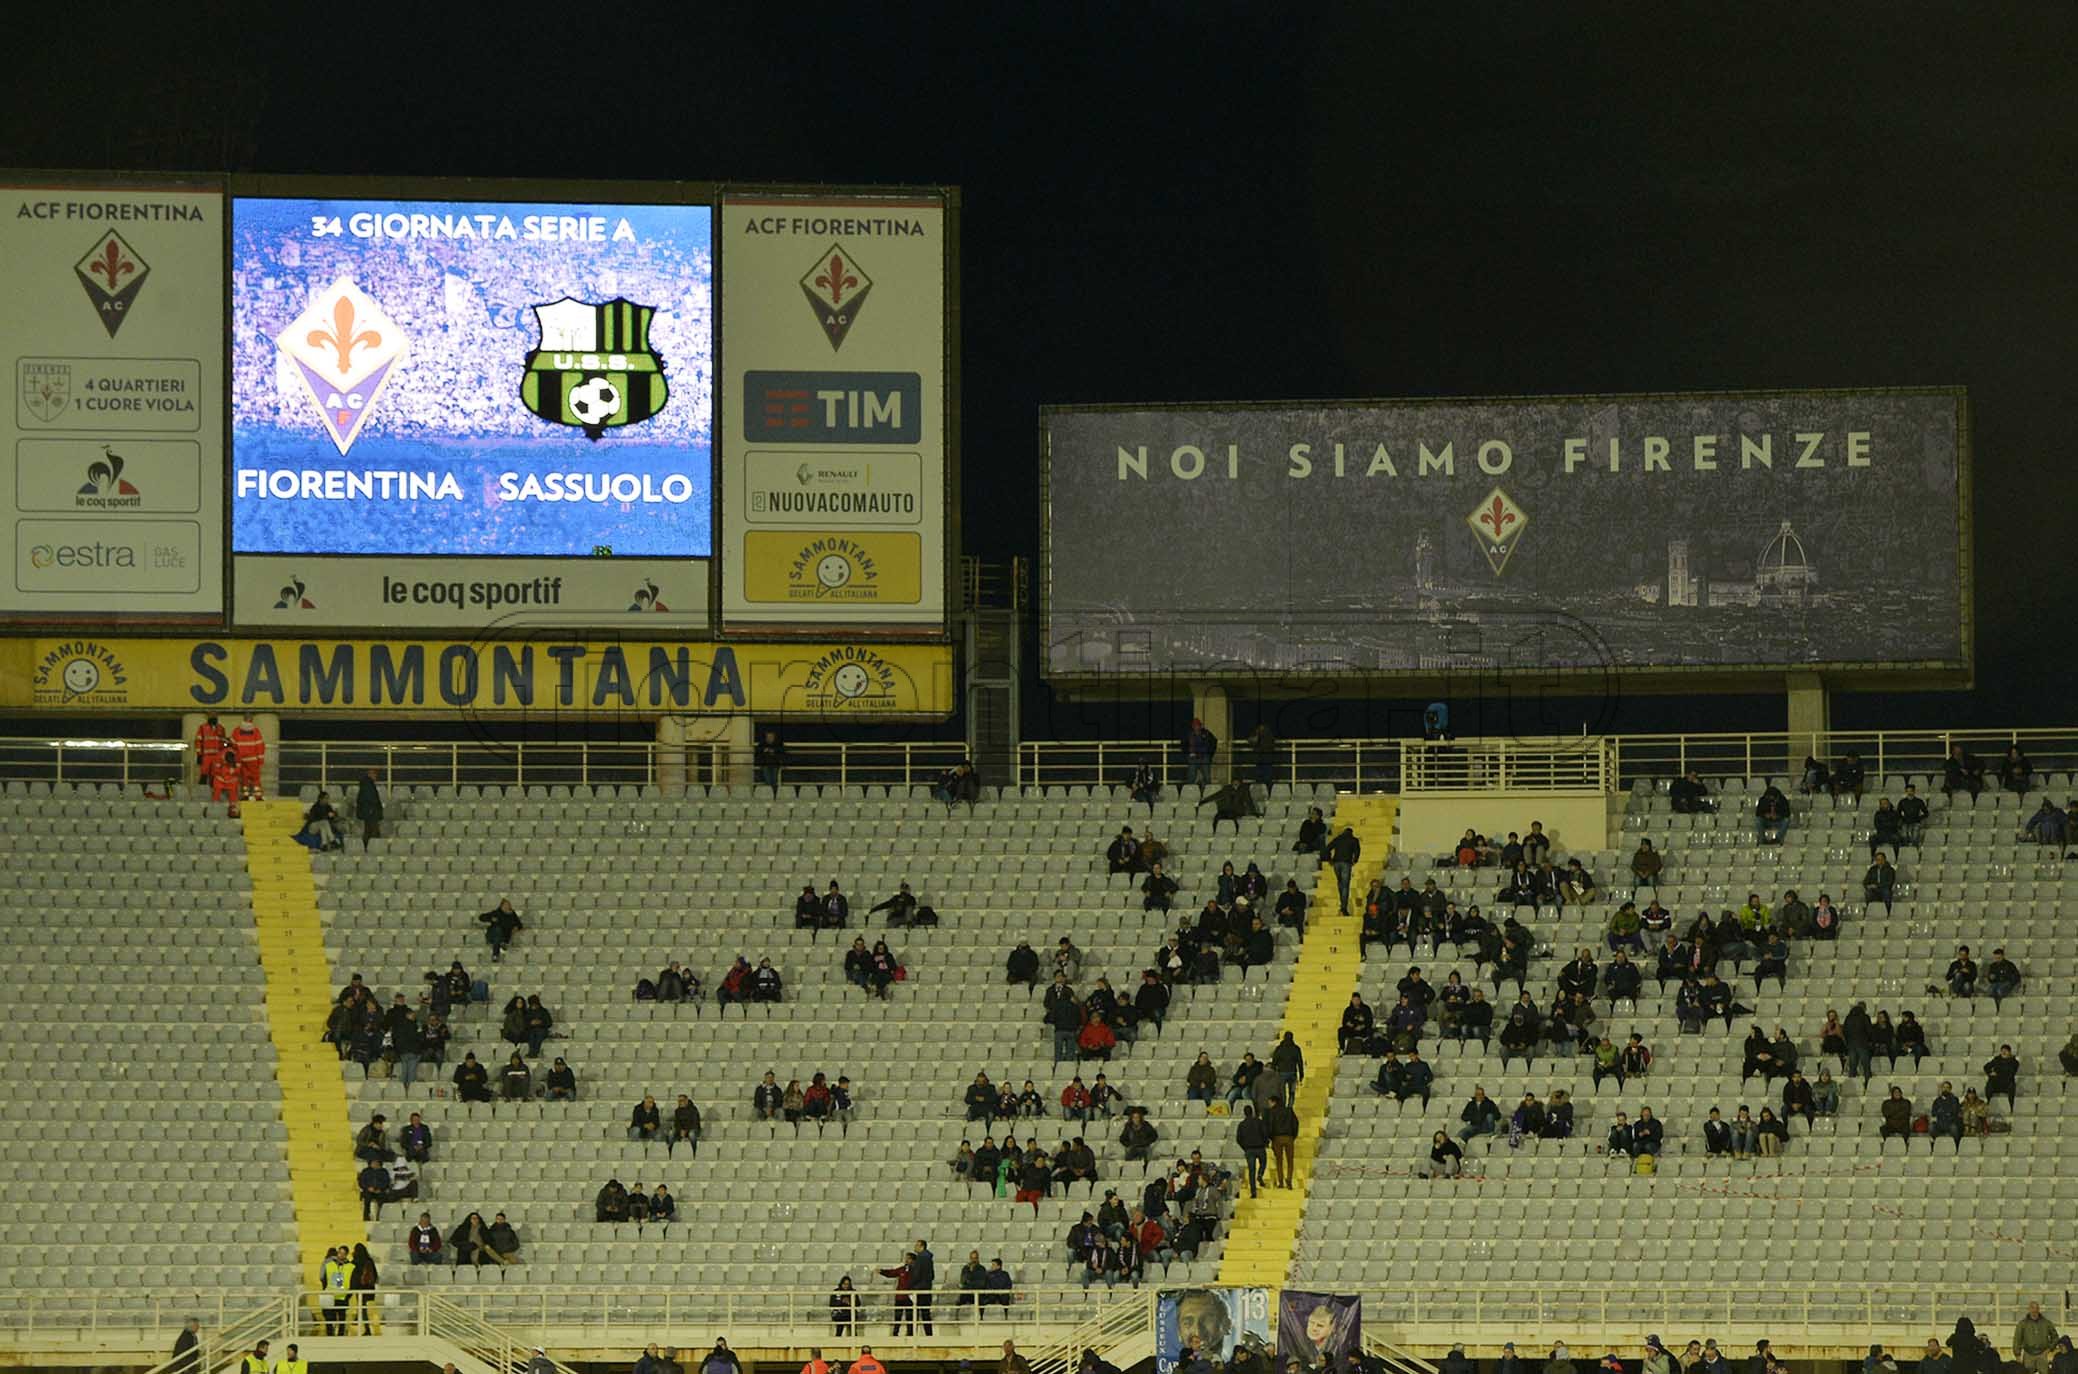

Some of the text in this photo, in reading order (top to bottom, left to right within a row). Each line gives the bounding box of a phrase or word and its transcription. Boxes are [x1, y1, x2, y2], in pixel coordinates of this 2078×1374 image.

[17, 203, 204, 221] ACF FIORENTINA
[311, 212, 636, 242] 34 GIORNATA SERIE A
[745, 217, 925, 236] ACF FIORENTINA
[85, 378, 185, 393] 4 QUARTIERI
[76, 398, 195, 412] 1 CUORE VIOLA
[816, 390, 903, 429] TIM
[1117, 431, 1872, 481] NOI SIAMO FIRENZE
[237, 469, 465, 500] FIORENTINA
[499, 471, 693, 503] SASSUOLO
[818, 470, 859, 479] RENAULT
[76, 496, 141, 509] le coq sportif
[768, 491, 915, 514] NUOVACOMAUTO
[56, 541, 136, 567] estra
[788, 536, 878, 581] SAMMONTANA
[383, 575, 562, 610] le coq sportif
[33, 641, 129, 686] SAMMONTANA
[189, 641, 747, 706] SAMMONTANA
[805, 646, 897, 690] SAMMONTANA
[1240, 1291, 1268, 1321] 13
